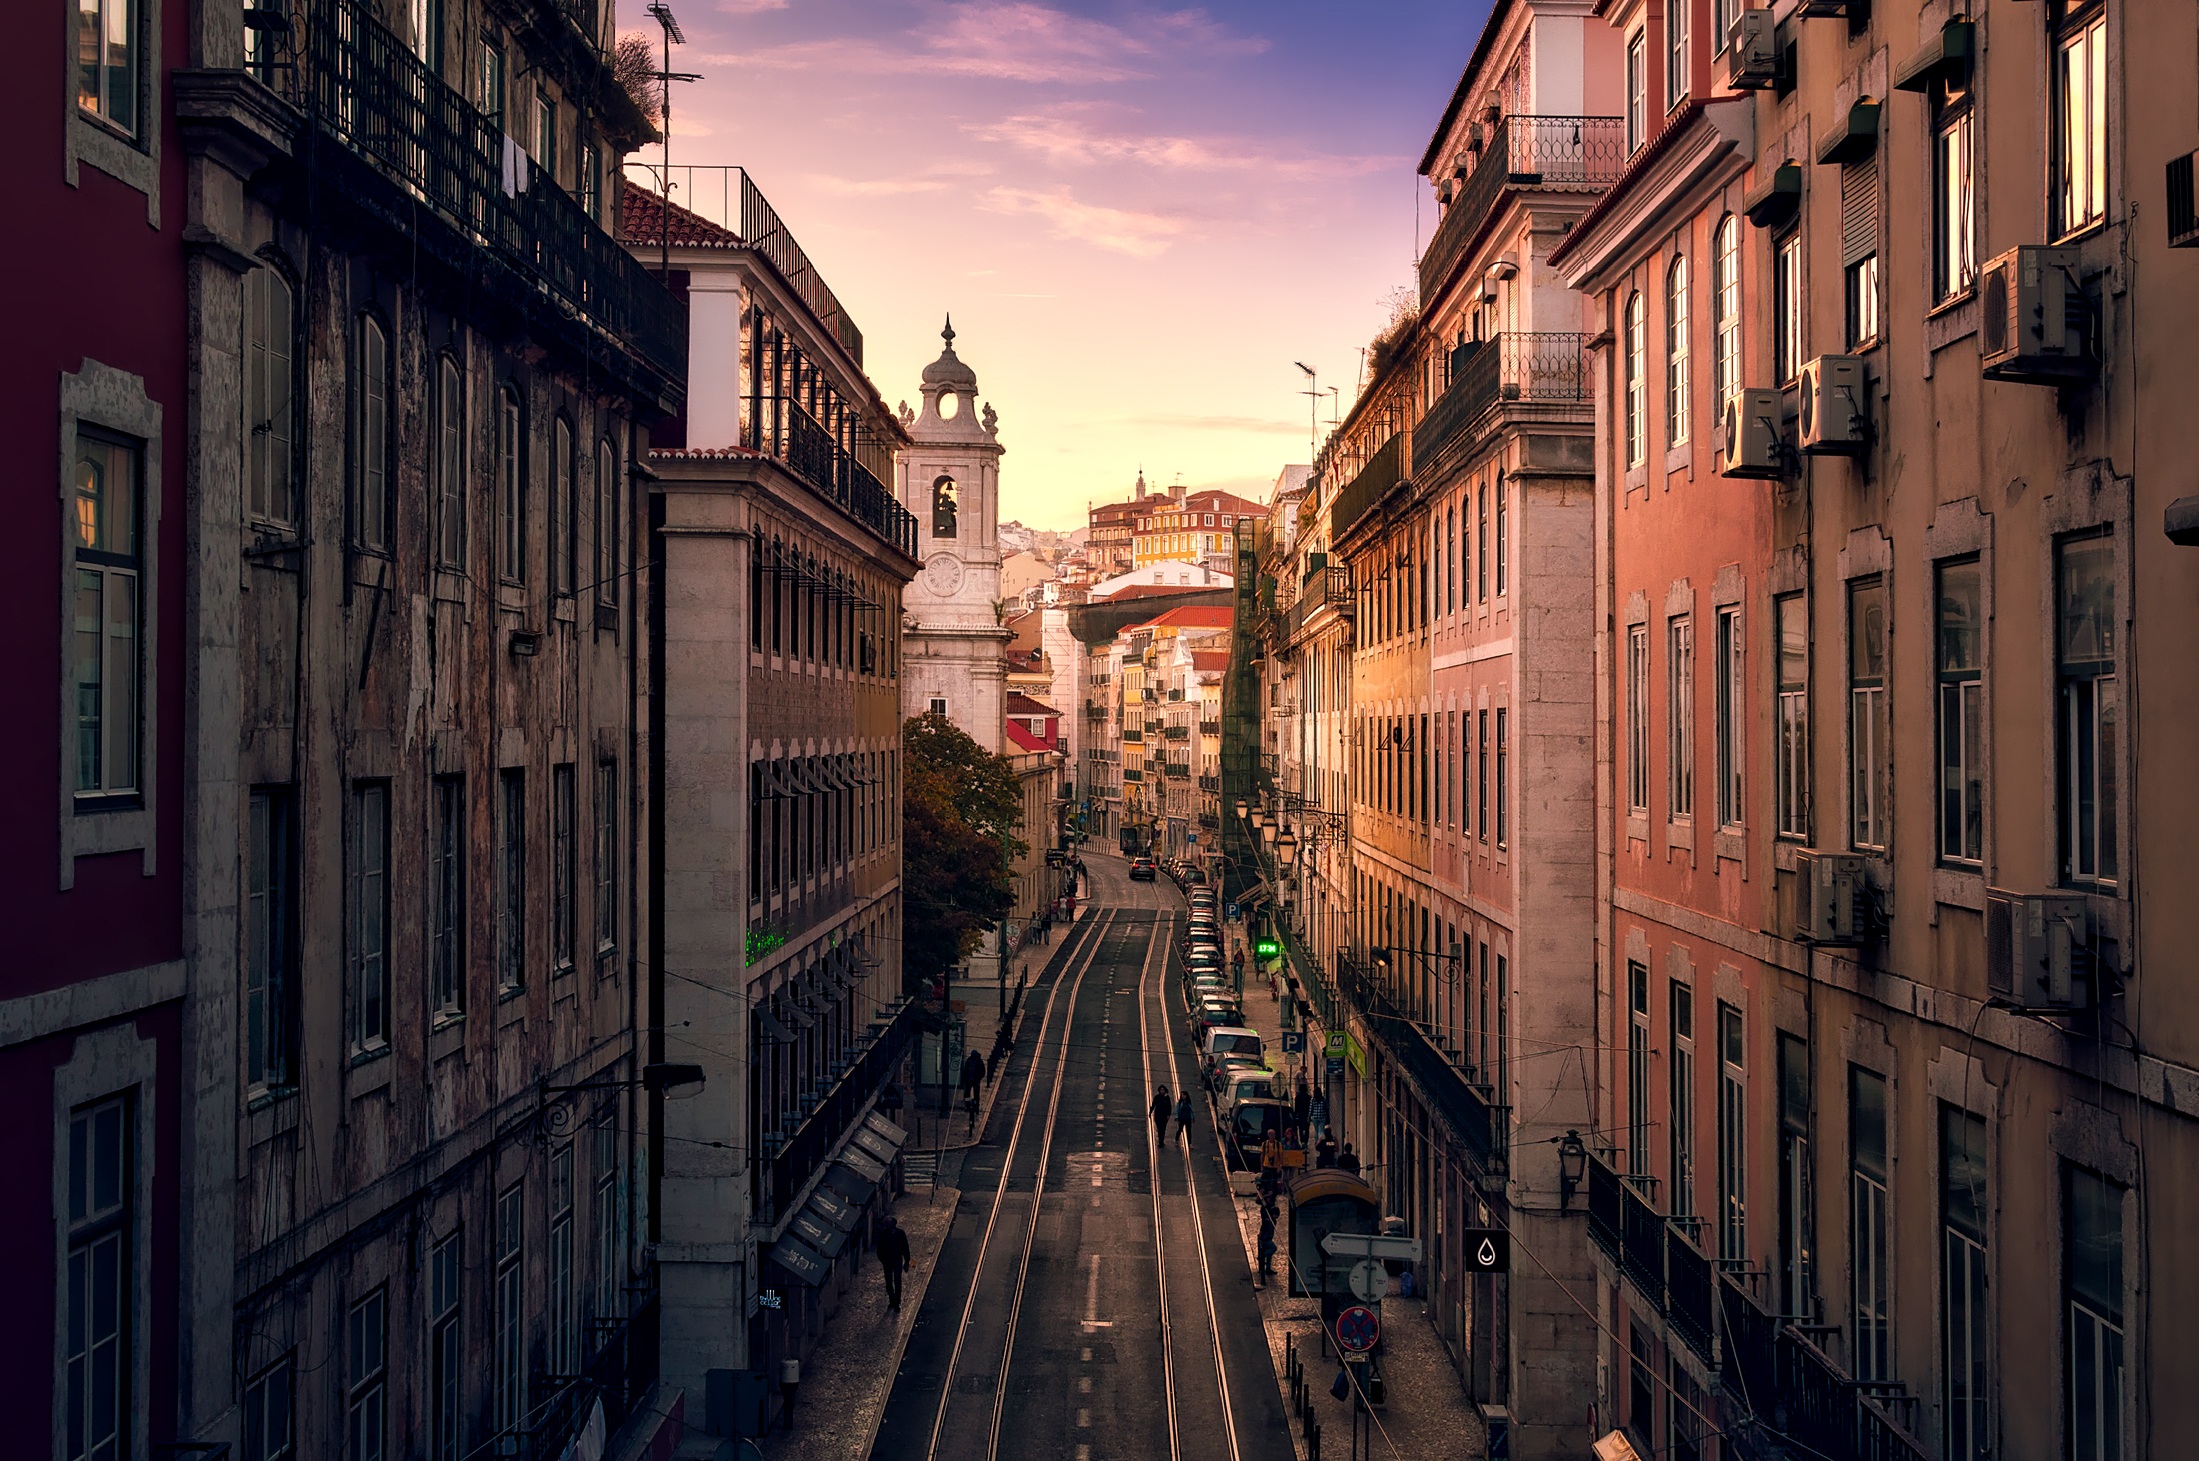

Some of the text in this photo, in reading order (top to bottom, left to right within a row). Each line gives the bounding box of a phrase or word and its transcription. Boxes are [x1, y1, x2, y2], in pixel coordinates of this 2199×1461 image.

[1228, 904, 1237, 914] P
[1286, 1035, 1298, 1050] P
[1331, 1036, 1343, 1046] M
